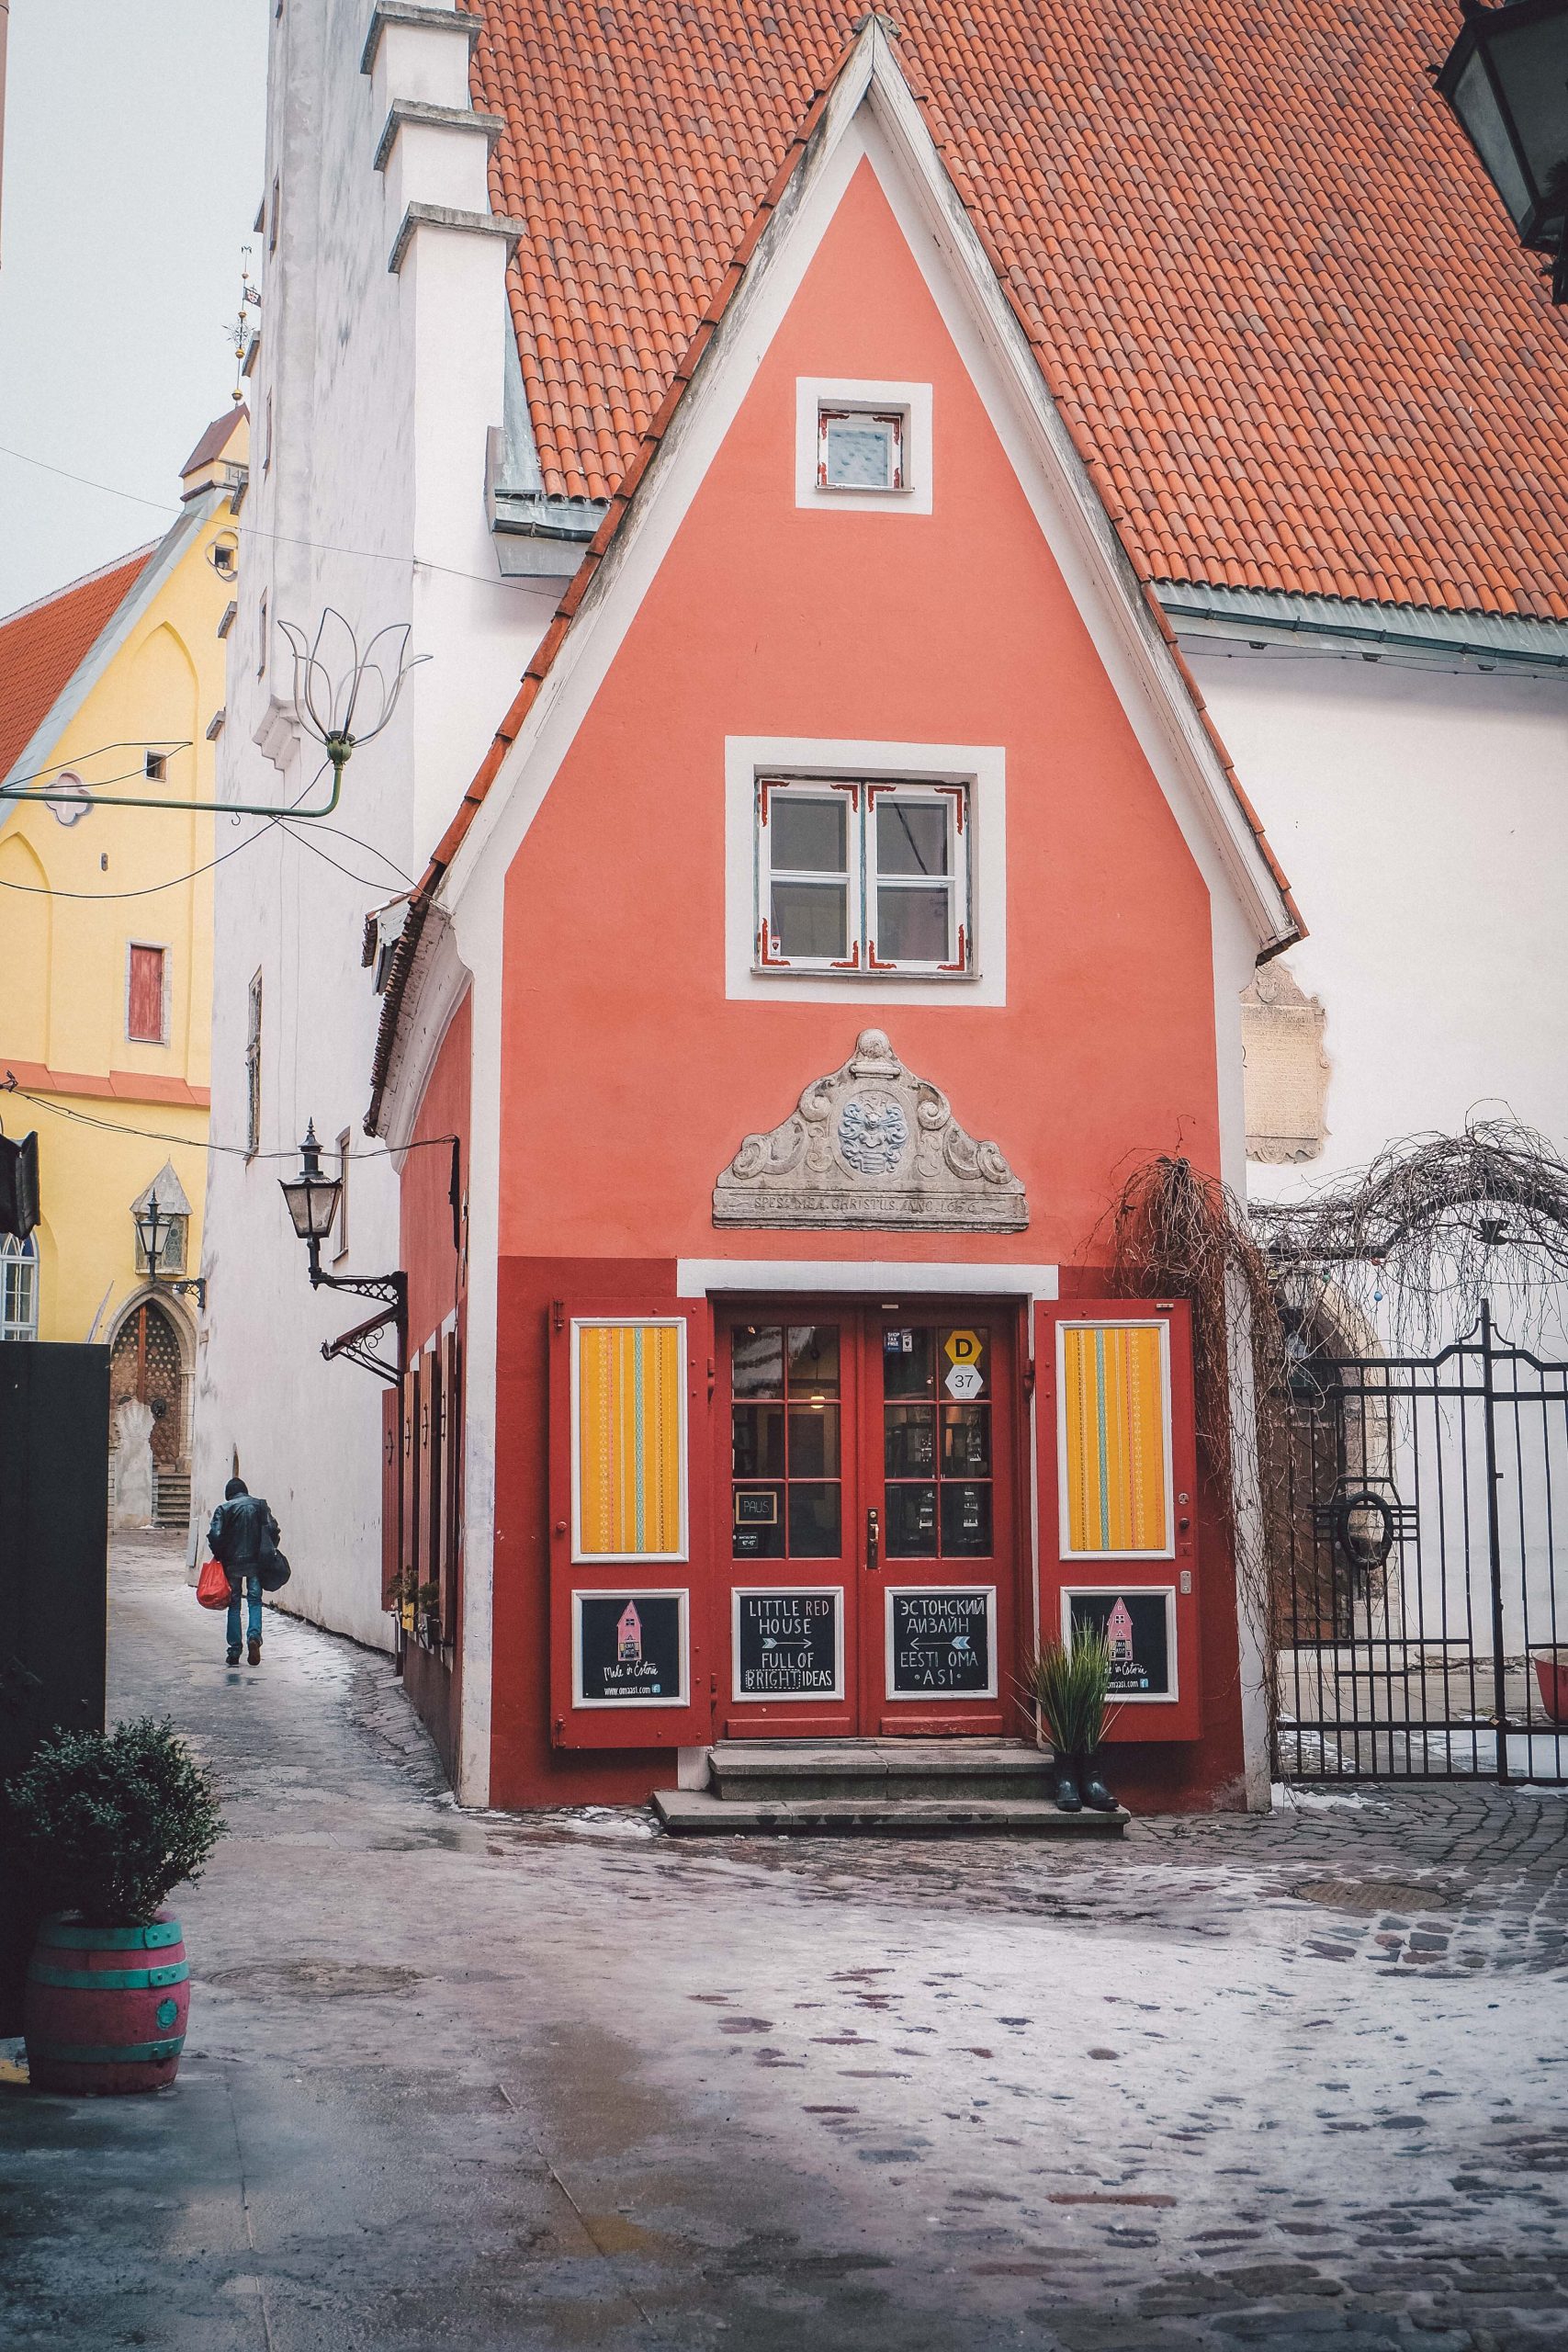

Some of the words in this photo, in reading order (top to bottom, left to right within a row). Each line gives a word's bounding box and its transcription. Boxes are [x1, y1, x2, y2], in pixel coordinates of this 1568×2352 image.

[955, 1338, 974, 1358] D
[954, 1374, 974, 1388] 37
[750, 1600, 799, 1616] LITTLE
[806, 1600, 829, 1616] RED
[900, 1597, 985, 1615] ЭСТОНСКИЙ
[759, 1619, 812, 1634] HOUSE
[906, 1616, 969, 1634] ДИЗАЙН
[761, 1653, 795, 1668] FULL
[797, 1652, 814, 1668] OF
[900, 1651, 939, 1668] EESTI
[948, 1651, 978, 1668] OMA
[603, 1664, 624, 1681] Made
[626, 1664, 633, 1675] in
[634, 1660, 659, 1677] Estonia
[1114, 1664, 1122, 1673] in
[1122, 1661, 1147, 1676] Estonia
[747, 1670, 799, 1687] BRIGHT
[802, 1670, 832, 1687] IDEAS
[604, 1686, 651, 1695] www.omaasi.com
